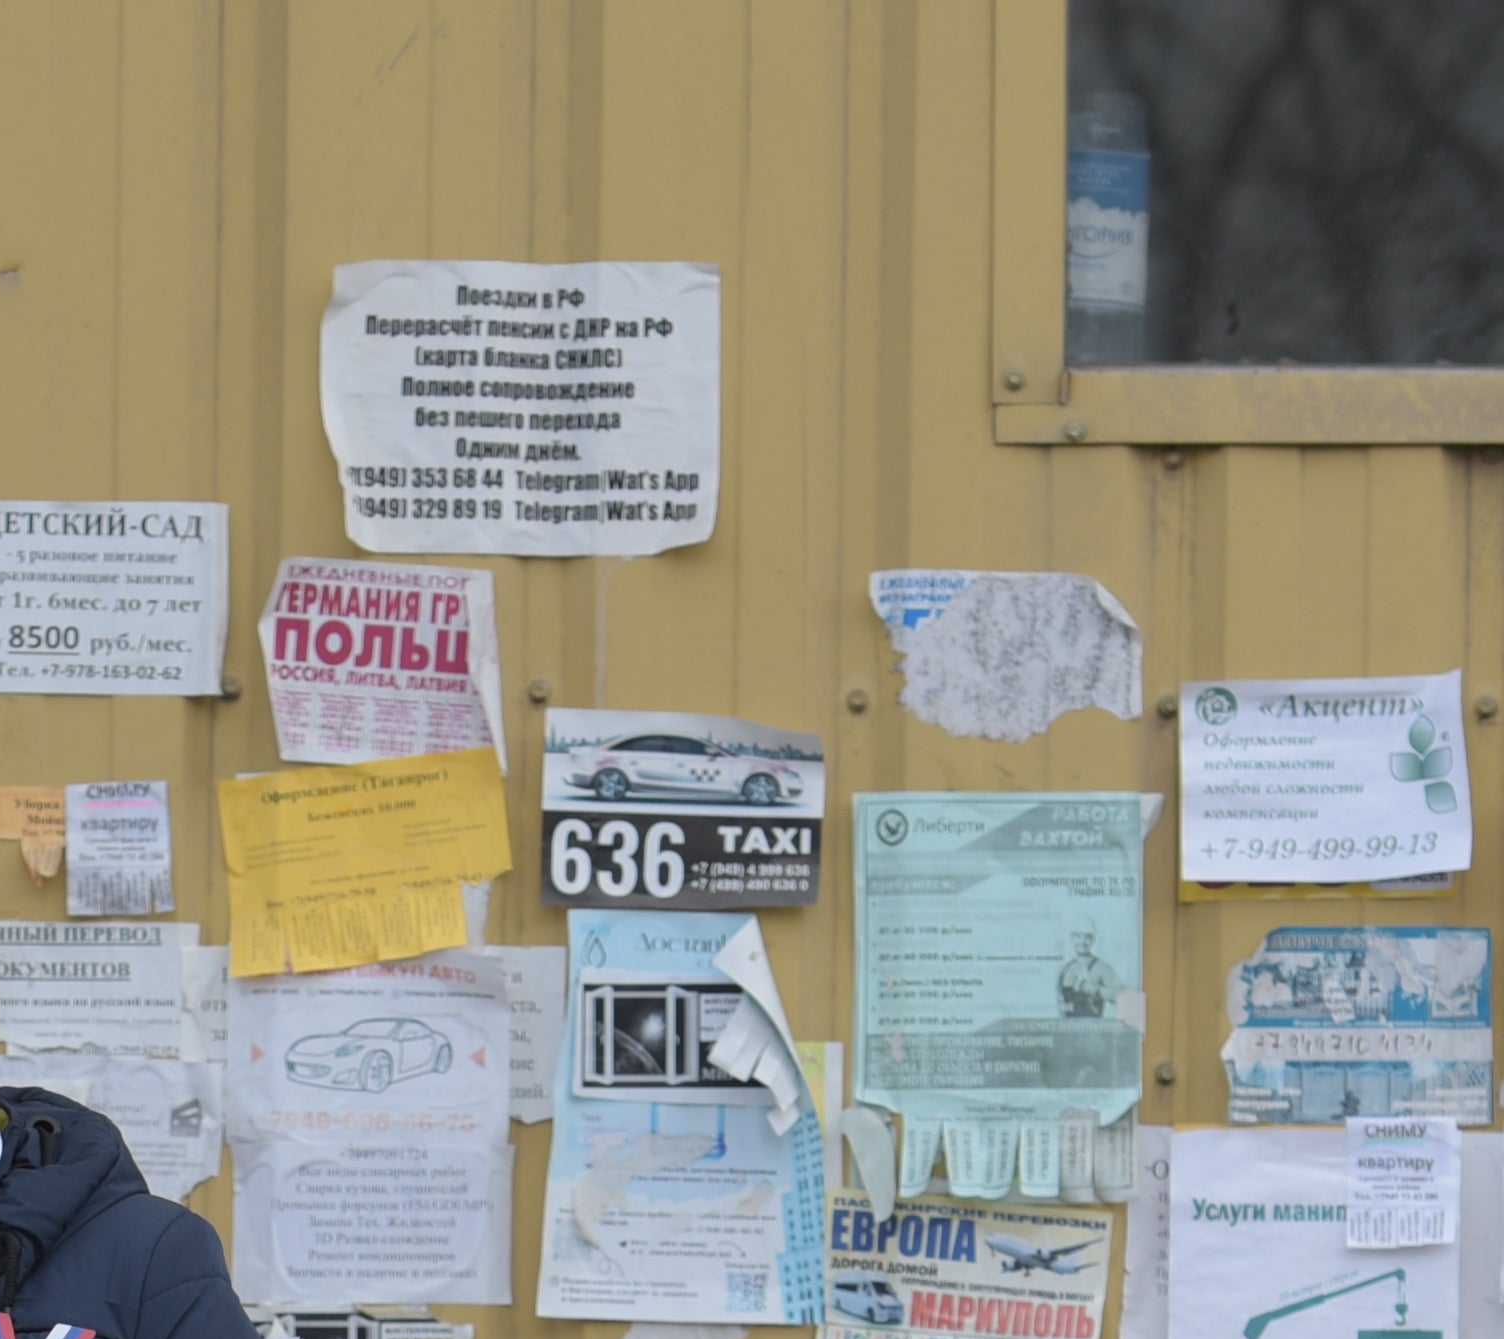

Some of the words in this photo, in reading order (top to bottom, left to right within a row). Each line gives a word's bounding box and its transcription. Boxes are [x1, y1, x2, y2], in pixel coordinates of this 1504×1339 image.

[457, 285, 537, 309] Поездки
[543, 292, 552, 308] в
[557, 286, 585, 308] РФ
[366, 313, 483, 340] Перерасчёт
[488, 320, 554, 338] пенсии
[559, 322, 570, 338] с
[575, 317, 611, 340] ДНР
[616, 320, 638, 338] на
[643, 317, 673, 338] РФ
[402, 378, 475, 398] Полное
[480, 380, 634, 402] сопровождение
[415, 408, 450, 428] без
[455, 412, 524, 431] пешего
[529, 410, 621, 433] перехода
[456, 439, 520, 459] Одним
[526, 439, 581, 462] днём.
[115, 595, 142, 613] до
[146, 599, 157, 614] 7
[163, 596, 201, 612] лет
[7, 625, 80, 650] 8500
[89, 633, 193, 655] руб./мес.
[40, 662, 182, 681] +7-978-163-02-62
[1258, 693, 1425, 721] «Акцент»
[717, 826, 811, 855] TAXI
[1200, 832, 1438, 861] +7-949-499-99-13
[551, 818, 685, 899] 636
[1356, 1154, 1435, 1174] квартиру
[1192, 1199, 1266, 1227] Услуги
[831, 1209, 978, 1263] ЕВРОПА
[909, 1291, 1096, 1339] МАРИУПОЛЬ
